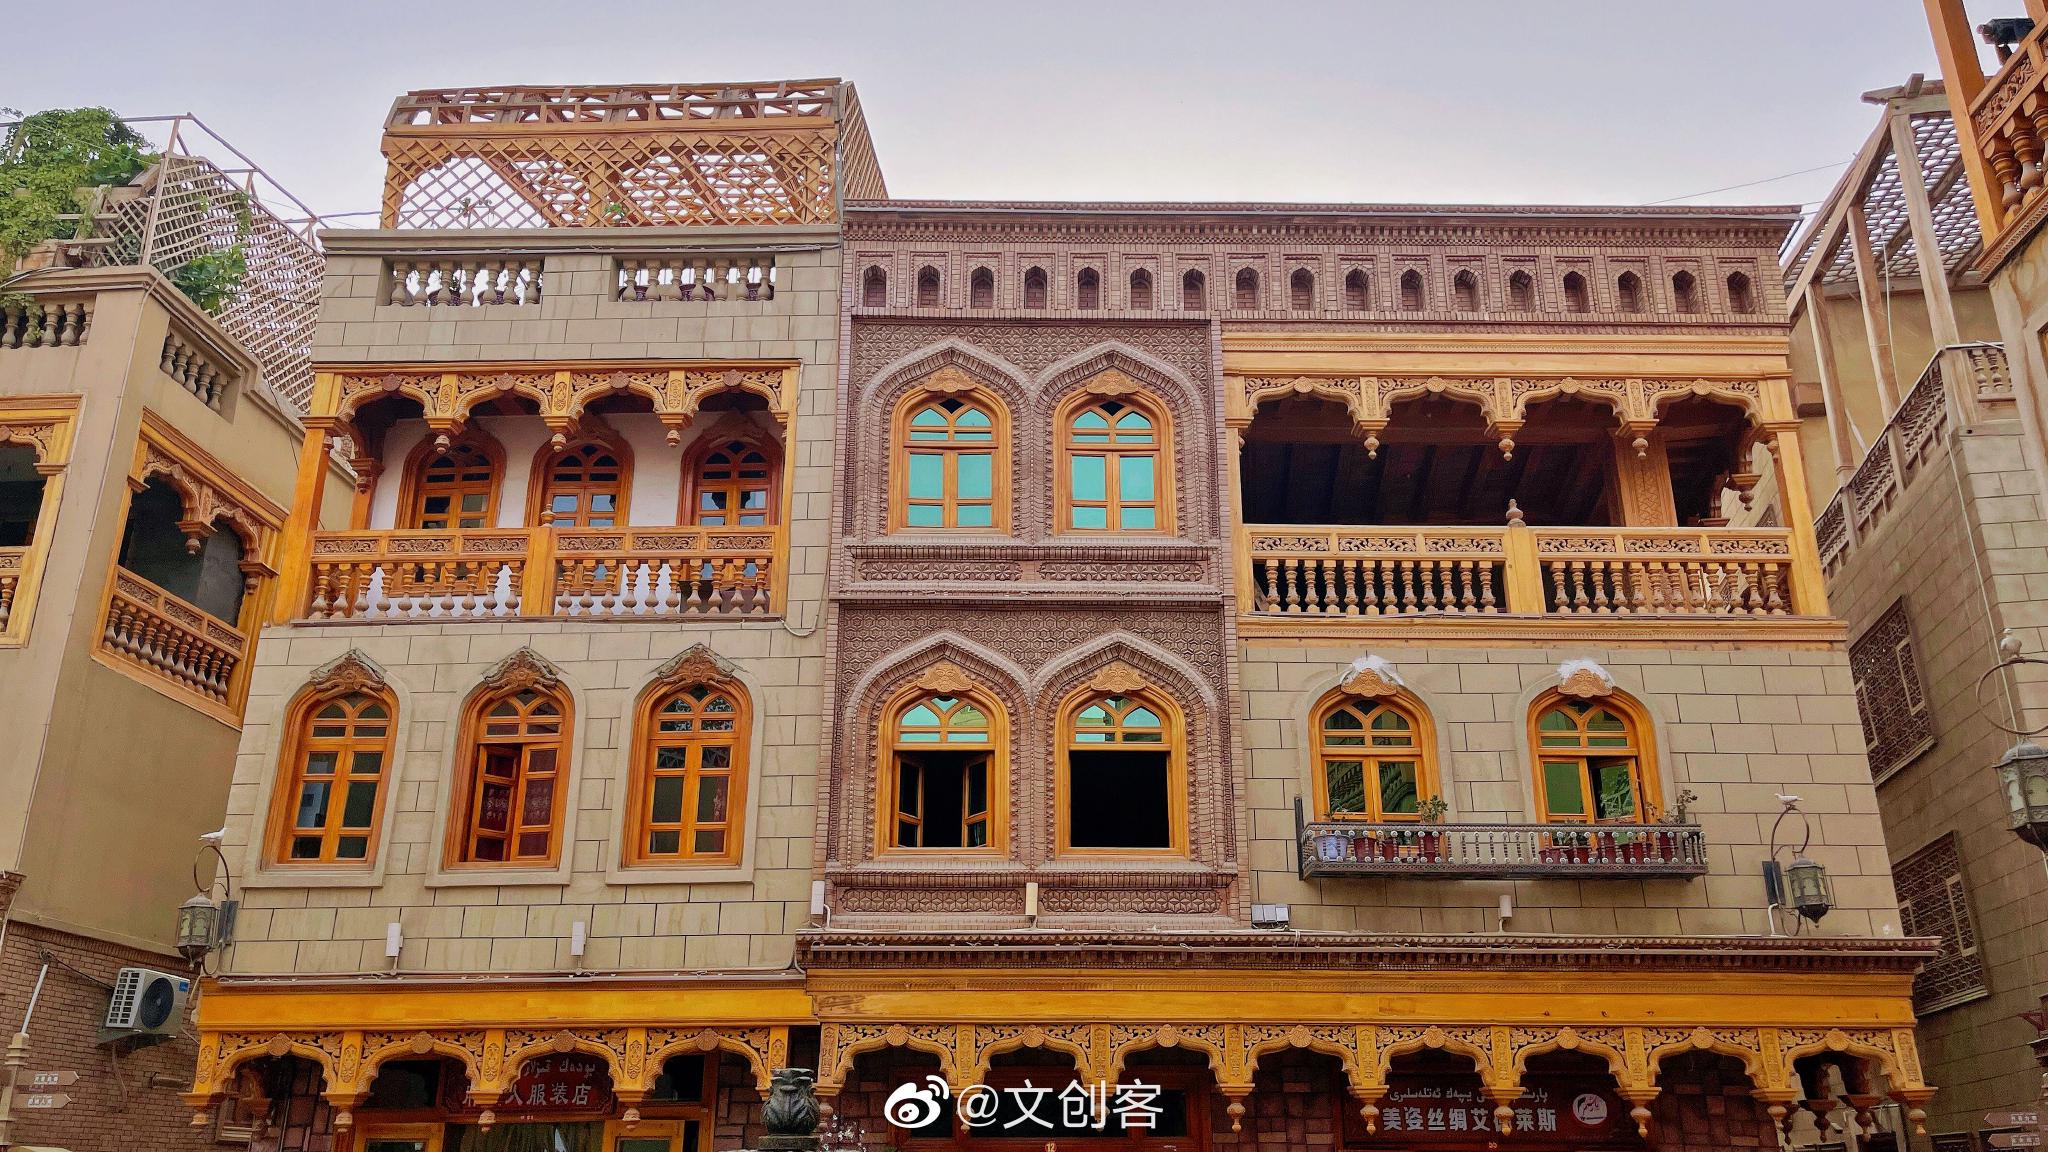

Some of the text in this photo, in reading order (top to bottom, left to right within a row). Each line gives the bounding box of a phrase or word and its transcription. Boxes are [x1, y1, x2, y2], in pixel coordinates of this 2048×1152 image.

[1382, 1106, 1557, 1132] 美姿丝绸艾莱斯
